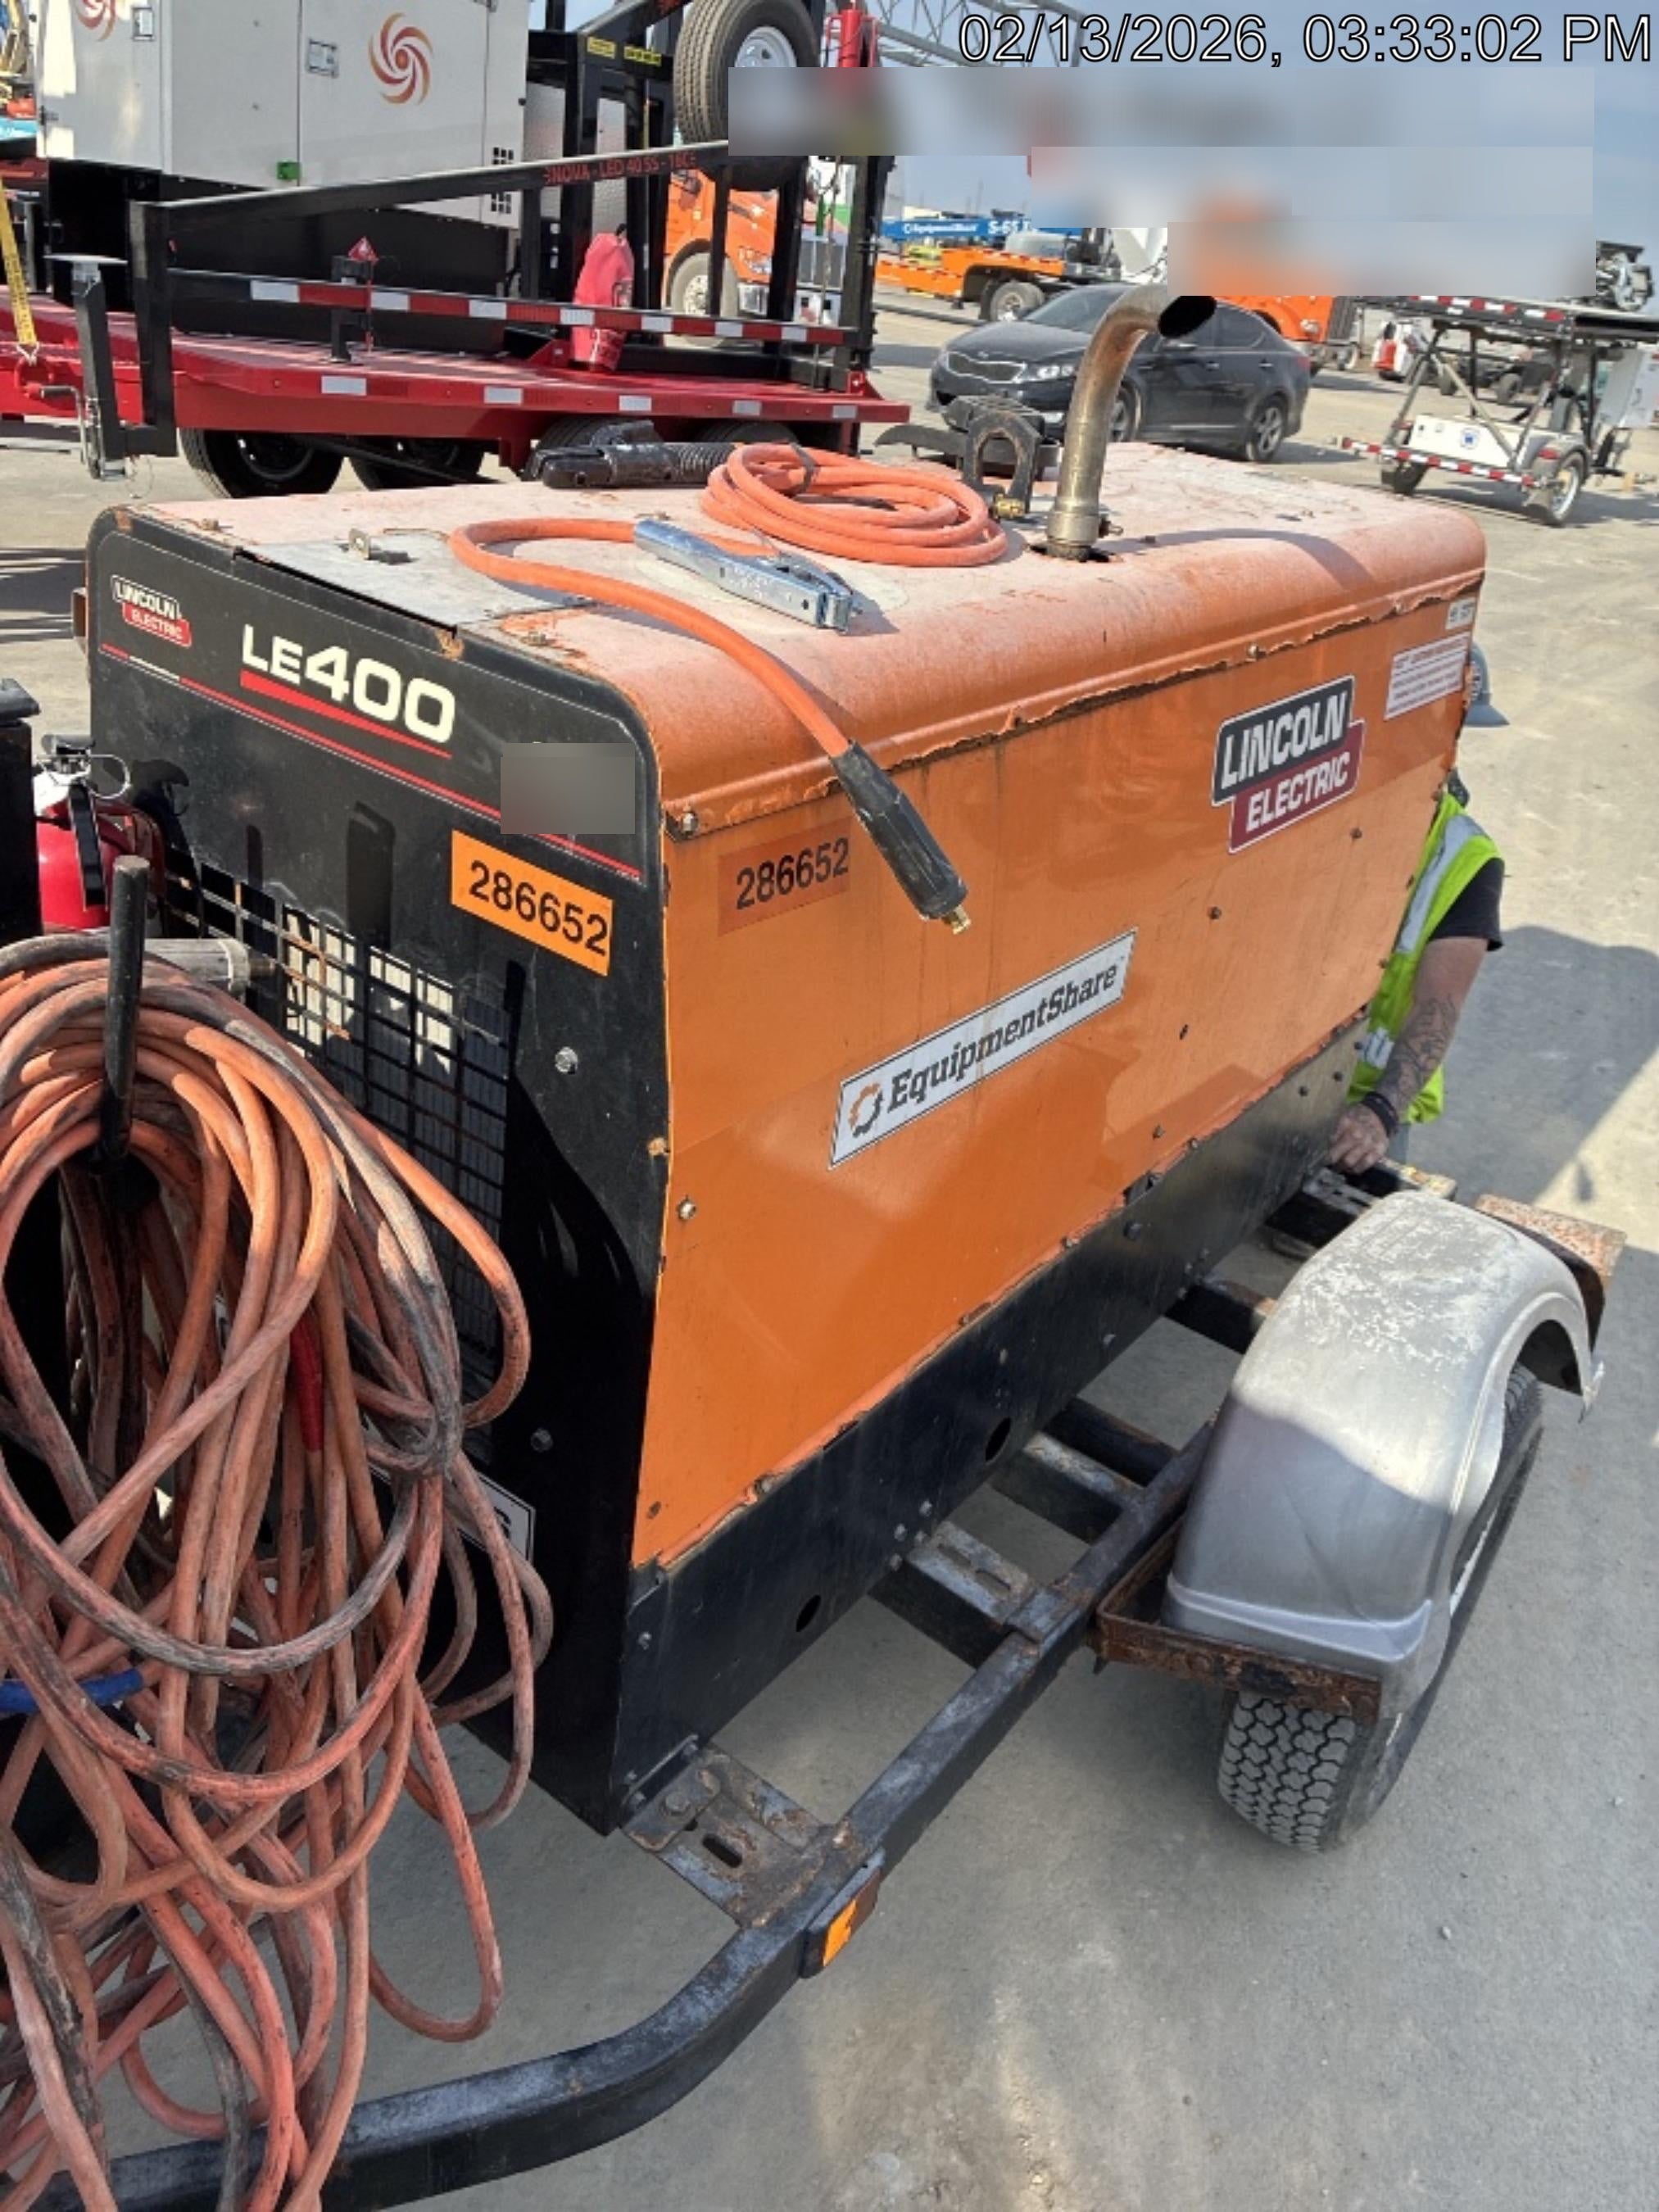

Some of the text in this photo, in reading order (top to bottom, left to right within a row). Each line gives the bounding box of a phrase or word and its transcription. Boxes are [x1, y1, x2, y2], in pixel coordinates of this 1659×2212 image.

[115, 581, 176, 620] LINCOLN
[131, 608, 183, 640] ELECTRIC
[243, 623, 455, 743] LE400
[1221, 691, 1348, 789] LINCOLN
[1246, 751, 1350, 832] ELECTRIC
[469, 859, 607, 957] 286652
[737, 836, 849, 910] 286652
[887, 963, 1117, 1113] EquipmentShare
